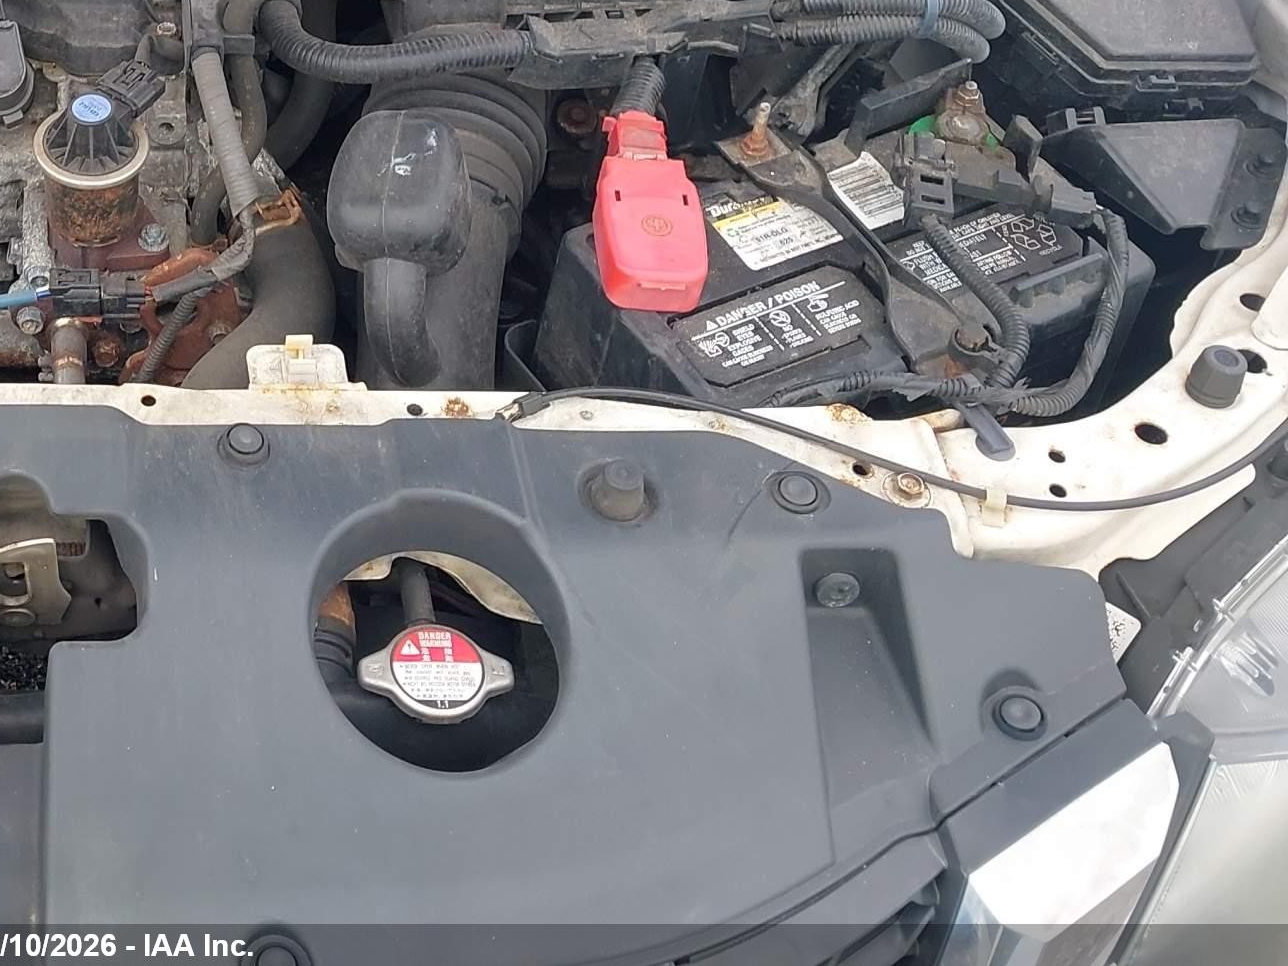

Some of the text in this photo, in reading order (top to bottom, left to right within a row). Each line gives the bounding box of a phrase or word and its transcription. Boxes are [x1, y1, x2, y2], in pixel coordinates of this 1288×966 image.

[715, 301, 768, 327] DANGER
[774, 281, 821, 305] POISON
[436, 700, 449, 709] 1.1
